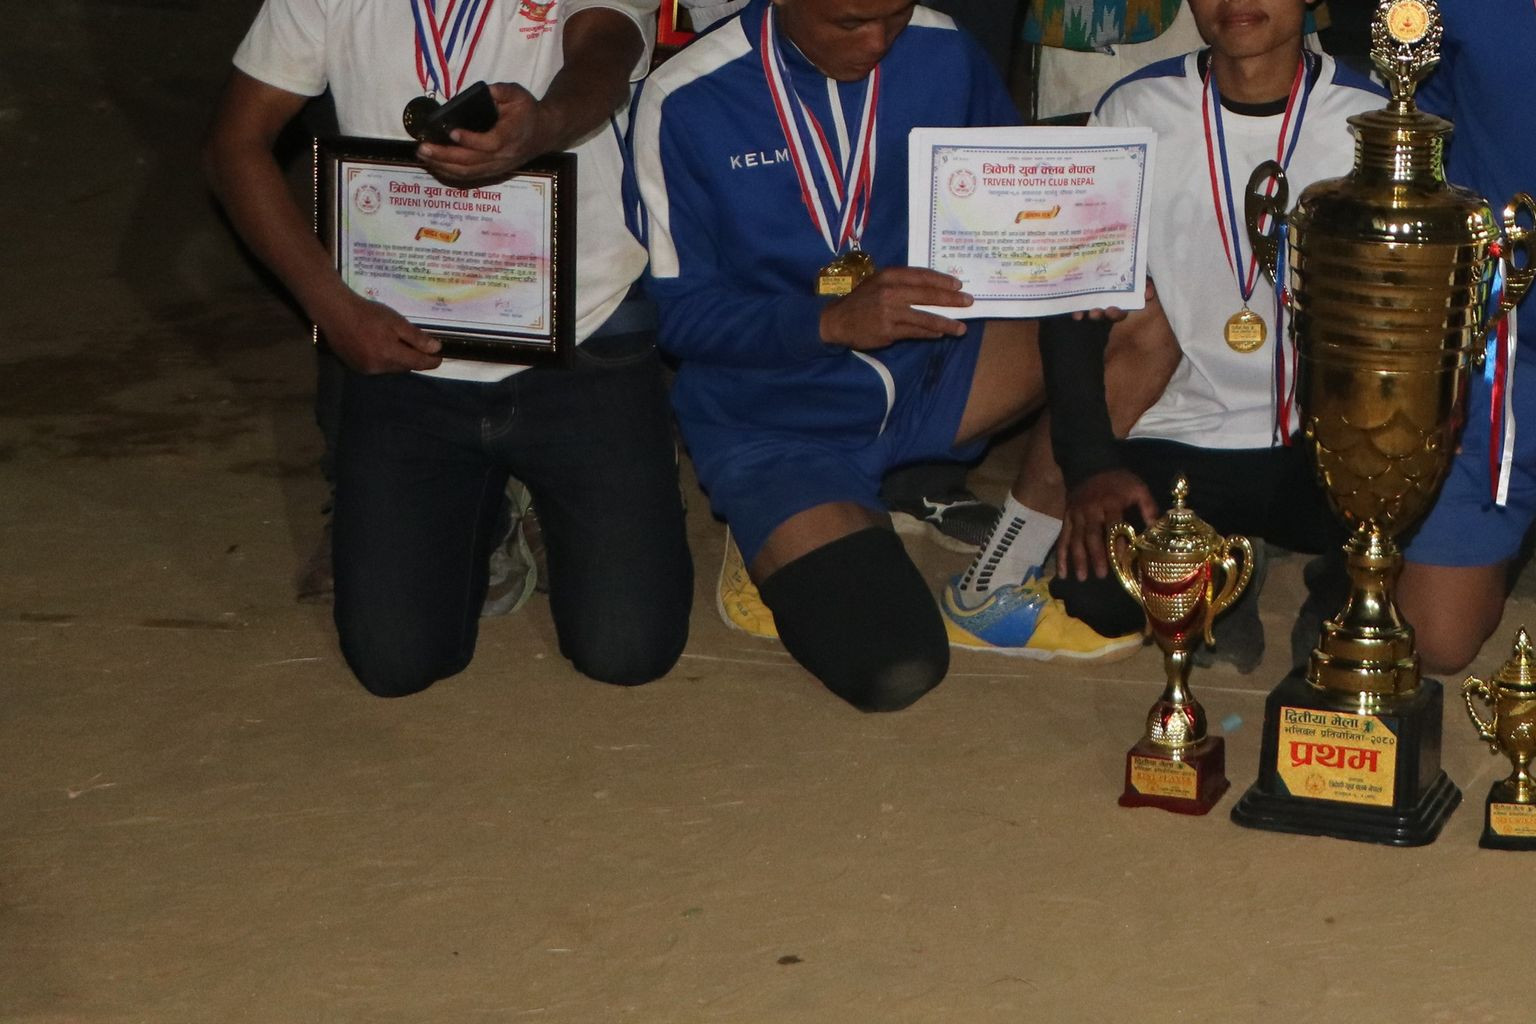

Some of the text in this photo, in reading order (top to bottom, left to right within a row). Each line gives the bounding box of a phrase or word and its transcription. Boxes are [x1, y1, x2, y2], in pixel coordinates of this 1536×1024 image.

[730, 148, 790, 170] KELM
[982, 176, 1095, 187] TRIVENI YOUTH CLUB NEPAL
[389, 196, 502, 214] TRIVENI YOUTH CLUB NEPAL
[1331, 714, 1358, 728] मेला
[1288, 741, 1382, 773] प्रथम
